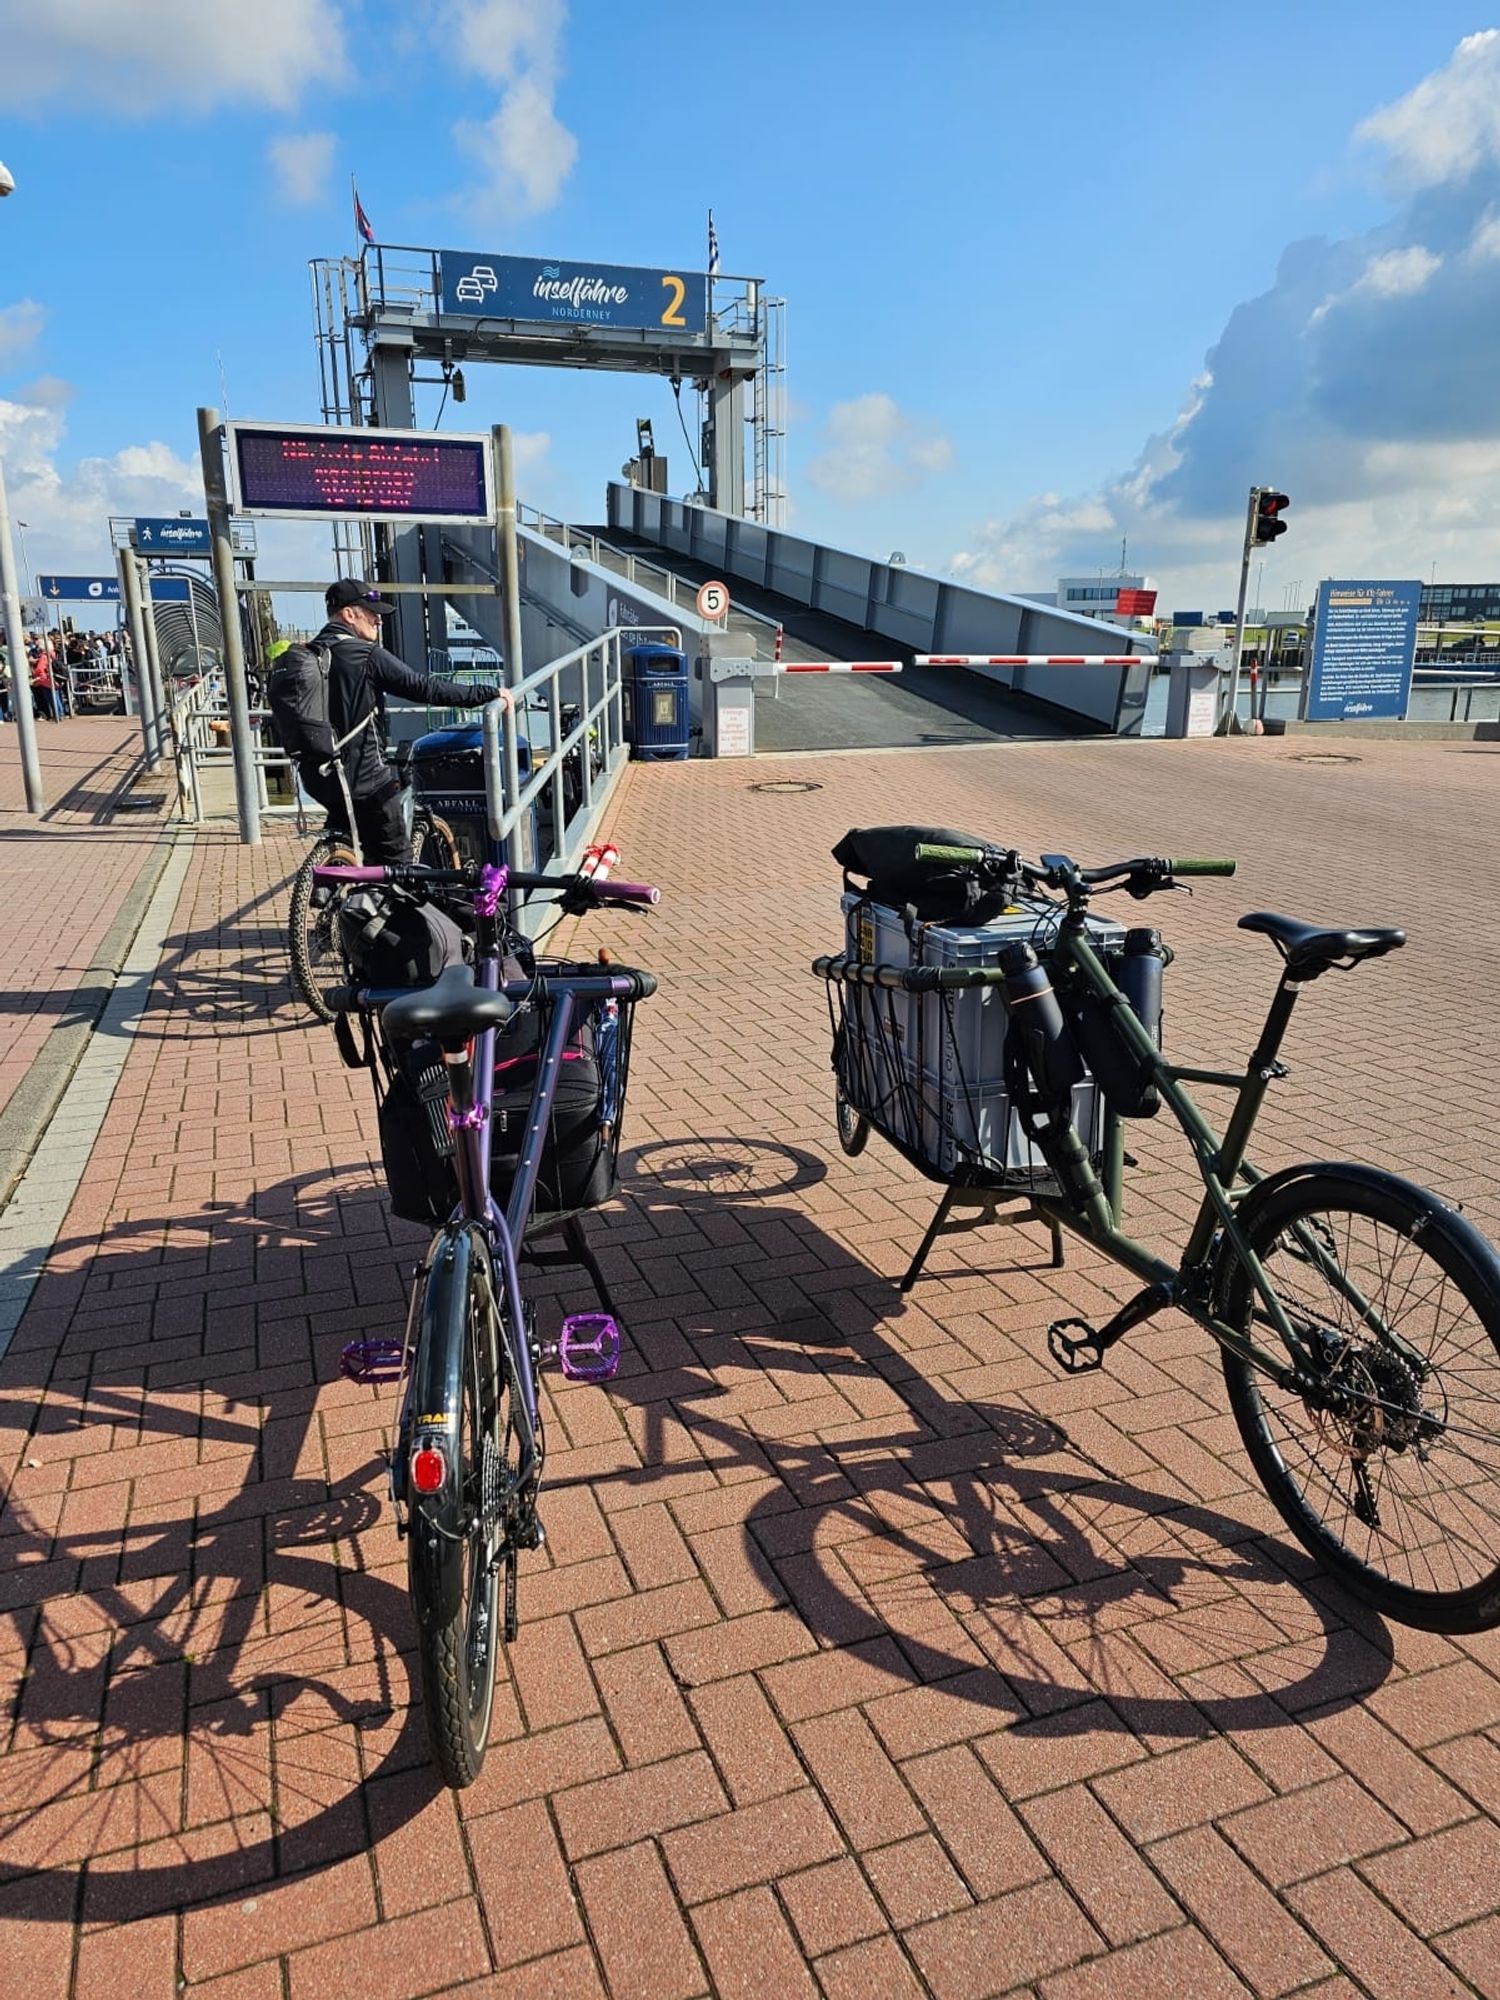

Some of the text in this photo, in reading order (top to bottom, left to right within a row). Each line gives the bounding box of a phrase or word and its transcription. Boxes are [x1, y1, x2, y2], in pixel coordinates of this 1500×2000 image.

[533, 274, 629, 308] inselfähre
[660, 275, 687, 327] 2
[552, 307, 611, 320] NORDERNEY
[707, 589, 720, 610] 5
[438, 800, 479, 808] ABFALL
[944, 1100, 955, 1163] LAER
